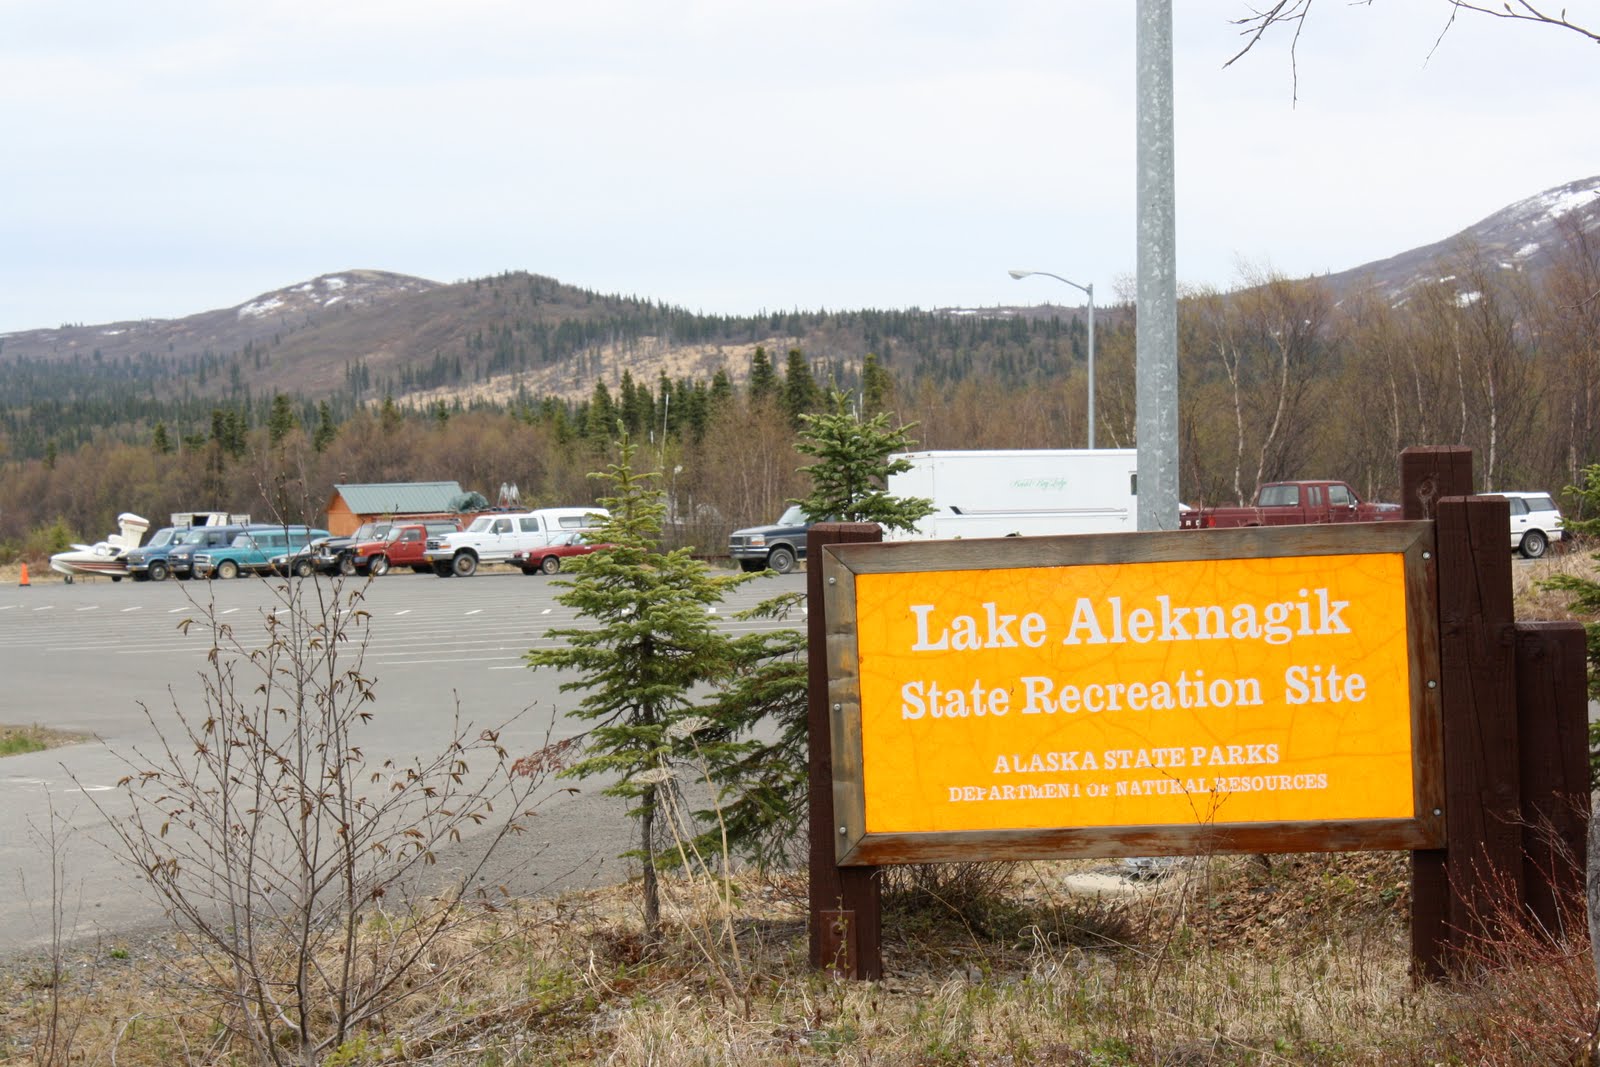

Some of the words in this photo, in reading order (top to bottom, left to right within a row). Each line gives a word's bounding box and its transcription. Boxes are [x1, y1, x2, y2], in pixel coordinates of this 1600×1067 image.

[909, 602, 1047, 652] Lake
[1062, 588, 1352, 646] Aleknagik
[901, 679, 1010, 720] State
[1020, 669, 1264, 715] Recreation
[1284, 664, 1367, 705] Site
[993, 751, 1099, 774] ALASKA
[1103, 747, 1186, 771] STATE
[1190, 744, 1280, 767] PARKS
[948, 782, 1081, 802] DEPARTMENT
[1115, 776, 1211, 797] NATURAL
[1214, 773, 1329, 793] RESOURCES
